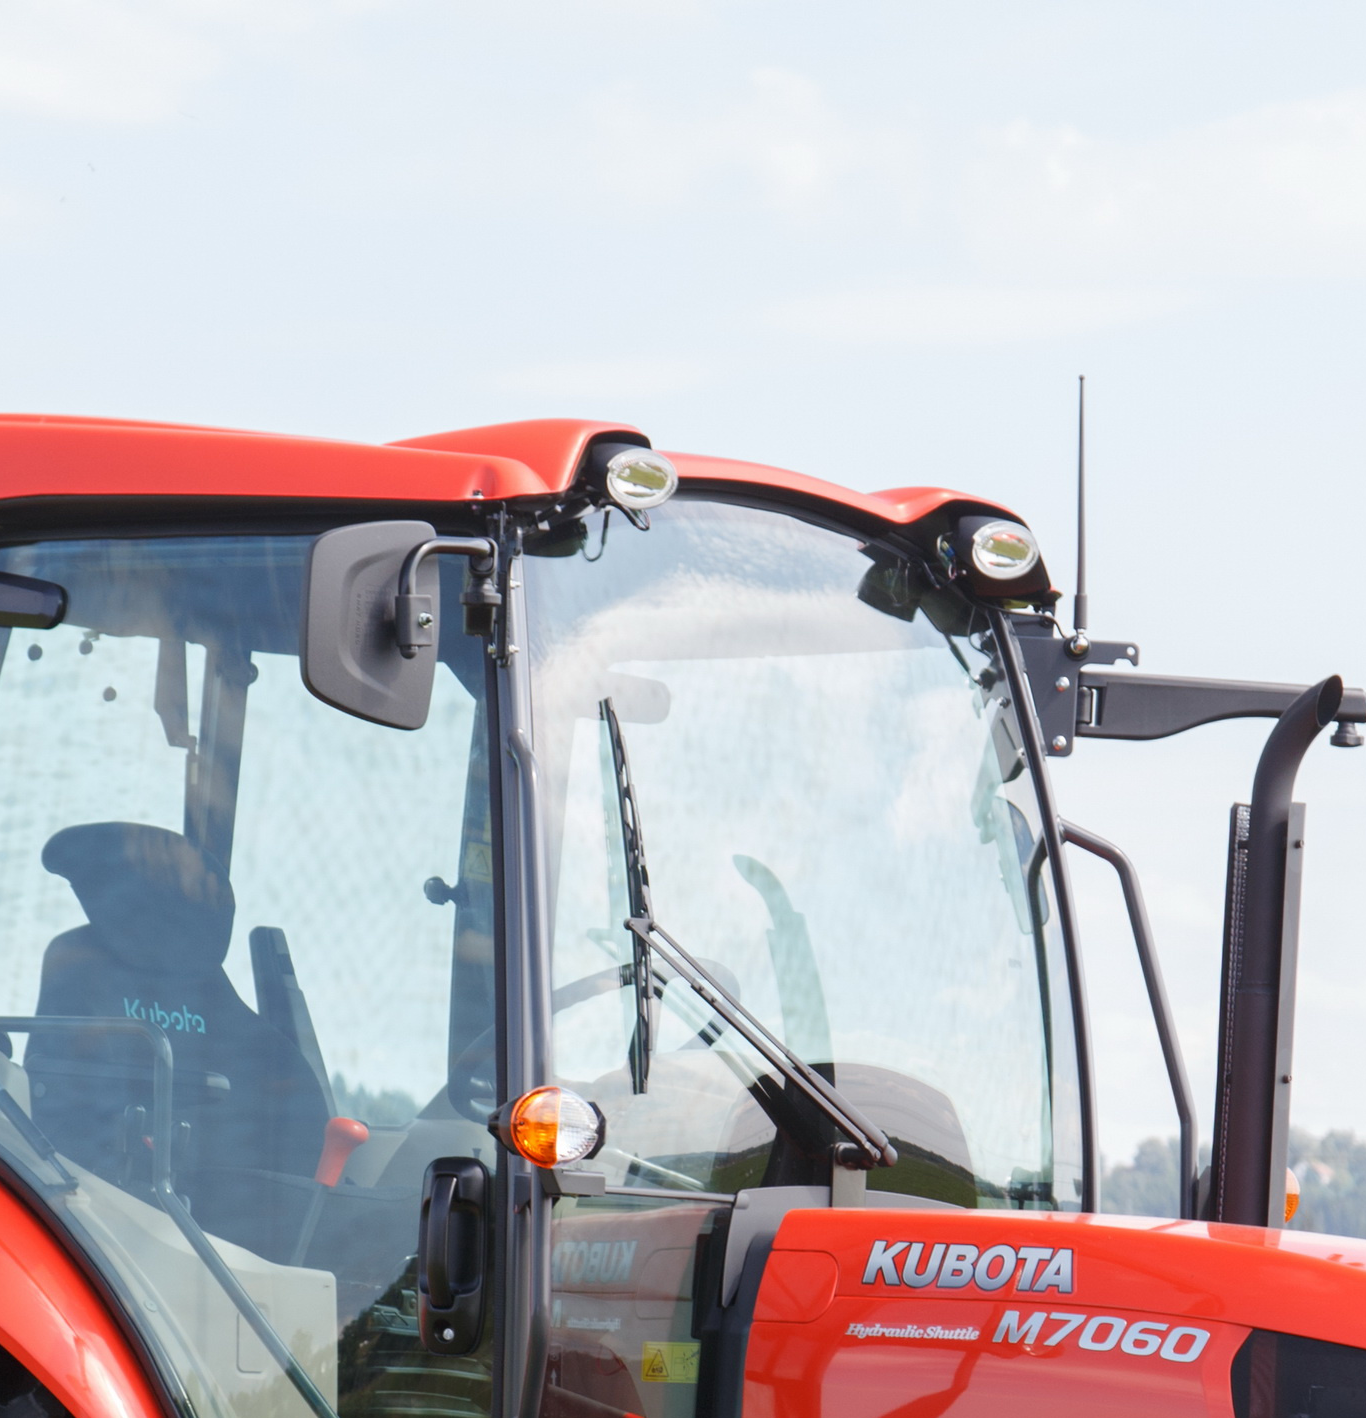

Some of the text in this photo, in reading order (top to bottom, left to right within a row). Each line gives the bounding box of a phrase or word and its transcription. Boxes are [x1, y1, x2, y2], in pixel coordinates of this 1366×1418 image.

[123, 997, 206, 1034] Kubota
[861, 1240, 1075, 1294] KUBOTA
[845, 1322, 980, 1341] Hydraulic Shuttle
[992, 1310, 1211, 1363] M7060
